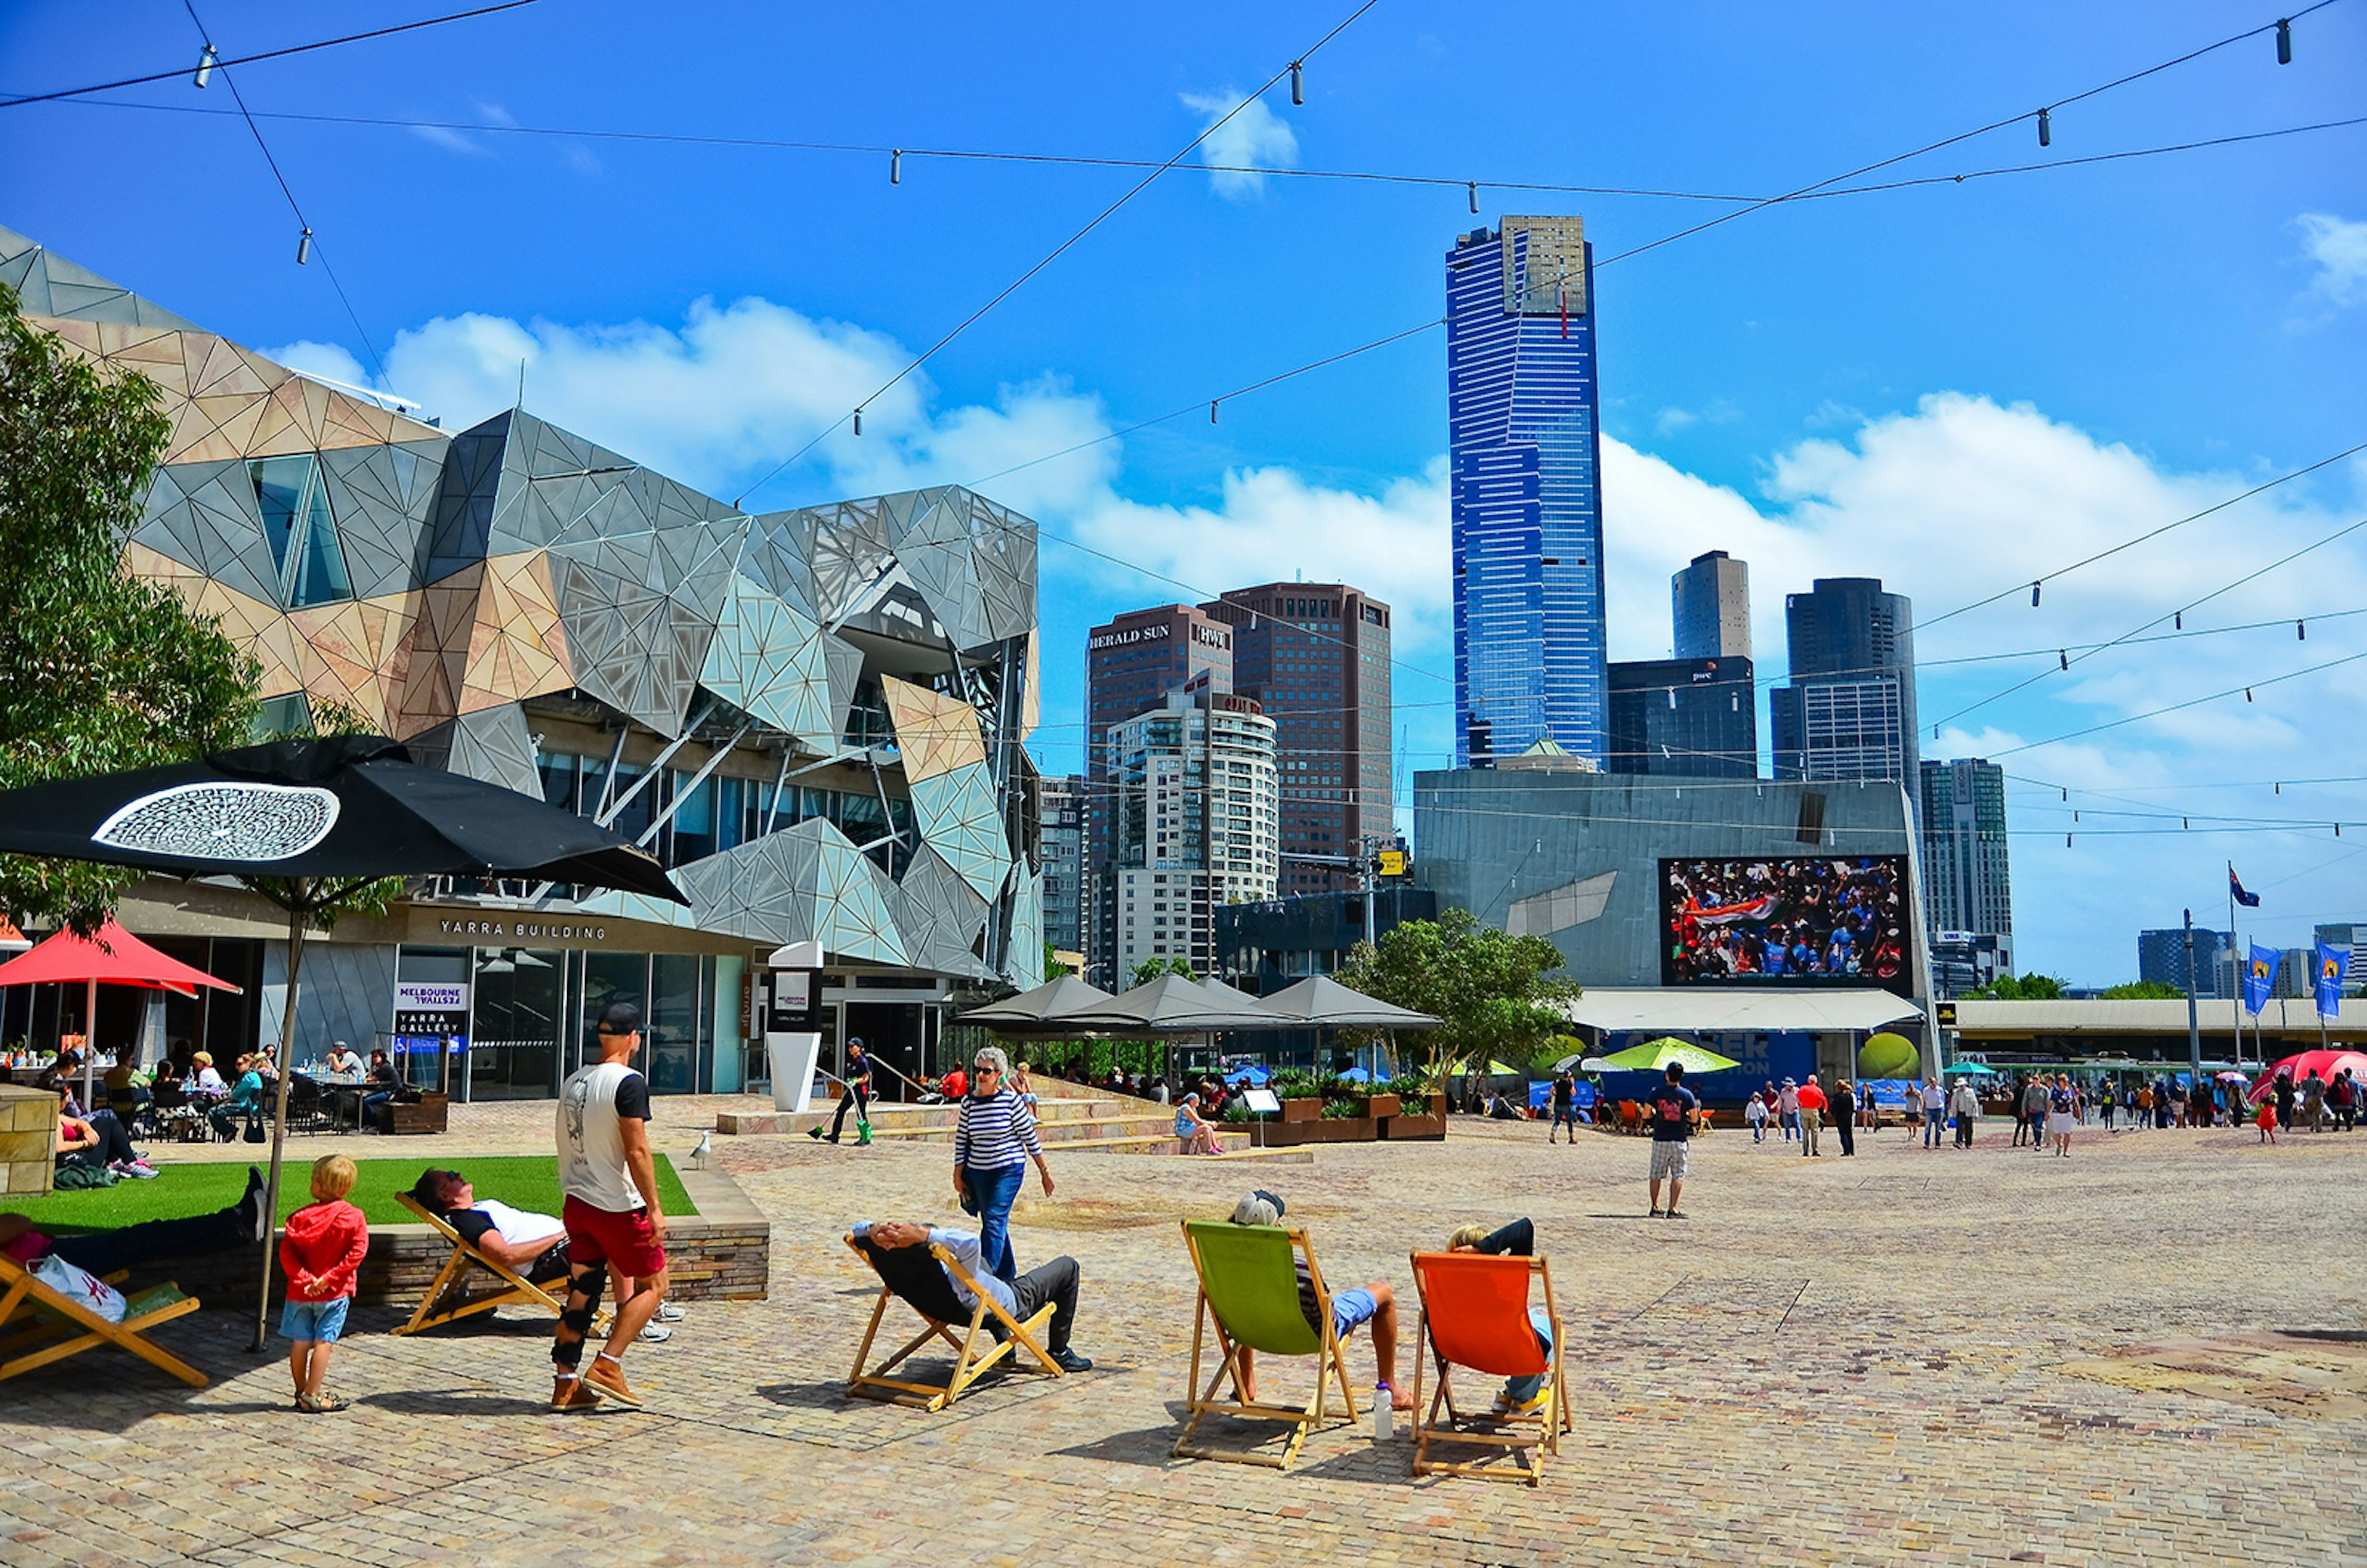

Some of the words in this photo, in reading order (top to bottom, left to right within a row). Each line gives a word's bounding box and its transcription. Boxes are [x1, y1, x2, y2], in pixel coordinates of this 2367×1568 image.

[1089, 630, 1140, 650] HERALD
[1143, 624, 1170, 640] SUN
[1201, 626, 1225, 647] HWT
[440, 920, 504, 936] YARRA
[515, 923, 605, 940] BUILDING
[400, 988, 460, 996] MELBOURNE
[415, 997, 460, 1005] FESTIVAL
[400, 1014, 445, 1023] YARRA
[400, 1024, 458, 1032] GALLERY
